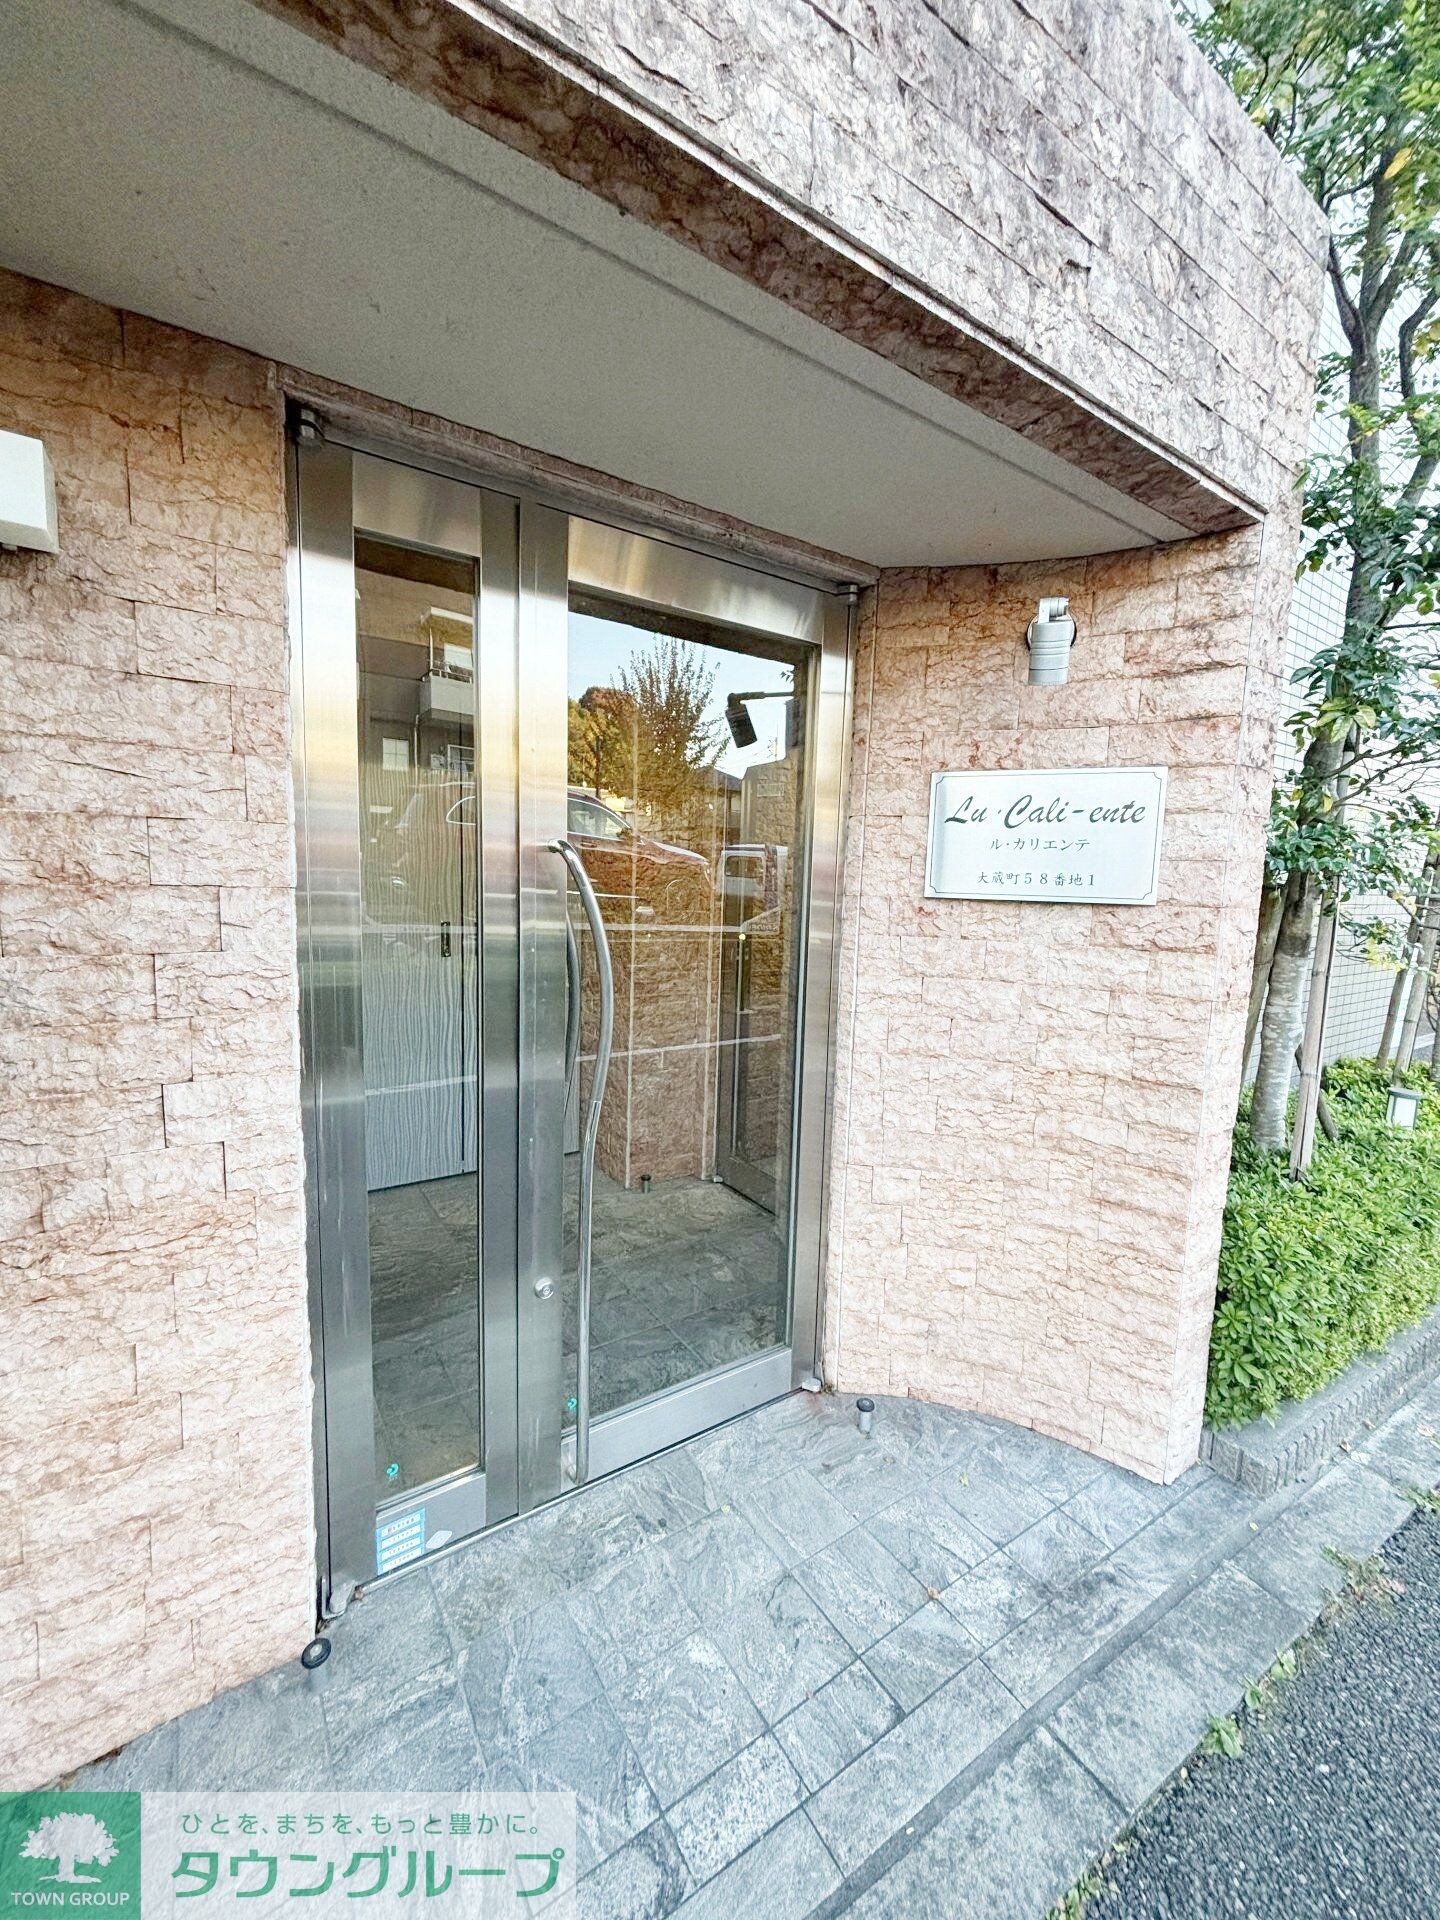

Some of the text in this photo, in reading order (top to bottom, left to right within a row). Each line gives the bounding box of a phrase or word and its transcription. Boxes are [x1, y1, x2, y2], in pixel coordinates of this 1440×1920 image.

[944, 796, 987, 824] Lu
[990, 837, 1090, 852] ル・カリエンテ
